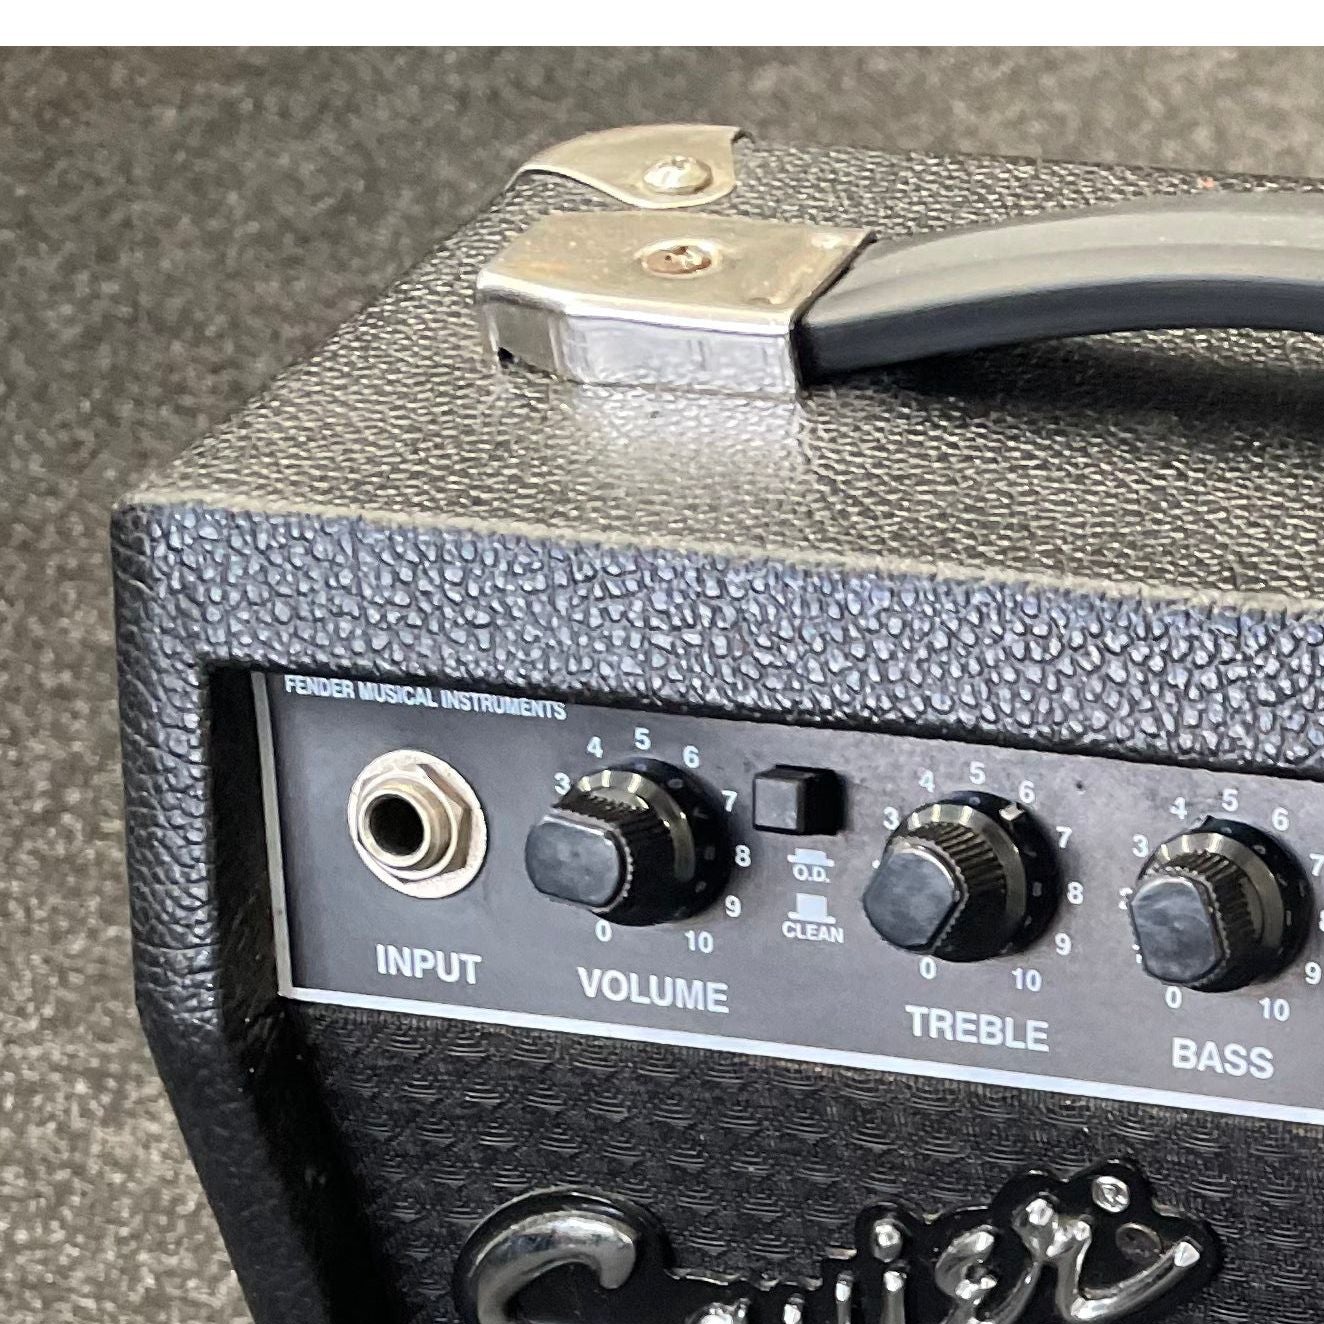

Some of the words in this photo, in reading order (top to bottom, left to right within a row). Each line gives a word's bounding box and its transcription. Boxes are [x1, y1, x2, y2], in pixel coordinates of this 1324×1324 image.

[284, 674, 355, 699] FENDER
[357, 681, 438, 708] MUSICAL
[440, 689, 567, 720] INSTRUMENTS
[586, 736, 603, 758] 4
[634, 727, 651, 750] 5
[682, 745, 700, 768] 6
[554, 772, 571, 795] 3
[918, 770, 936, 793] 4
[969, 761, 986, 785] 5
[721, 790, 738, 813] 7
[1018, 779, 1035, 803] 6
[1221, 788, 1239, 812] 5
[883, 806, 900, 830] 3
[1170, 797, 1187, 819] 4
[1272, 808, 1289, 831] 6
[1056, 826, 1072, 848] 7
[1132, 834, 1149, 857] 3
[735, 844, 751, 867] 8
[1067, 881, 1084, 904] 8
[725, 895, 741, 917] 9
[595, 920, 612, 942] 0
[684, 931, 714, 954] 10
[782, 920, 844, 943] CLEAN
[1055, 933, 1072, 956] 9
[375, 943, 482, 985] INPUT
[919, 958, 937, 980] 0
[1304, 962, 1321, 985] 9
[577, 966, 730, 1014] VOLUME
[1012, 967, 1042, 992] 10
[1165, 986, 1182, 1009] 0
[1258, 998, 1290, 1021] 10
[905, 1004, 1049, 1052] TREBLE
[1172, 1036, 1274, 1079] BASS
